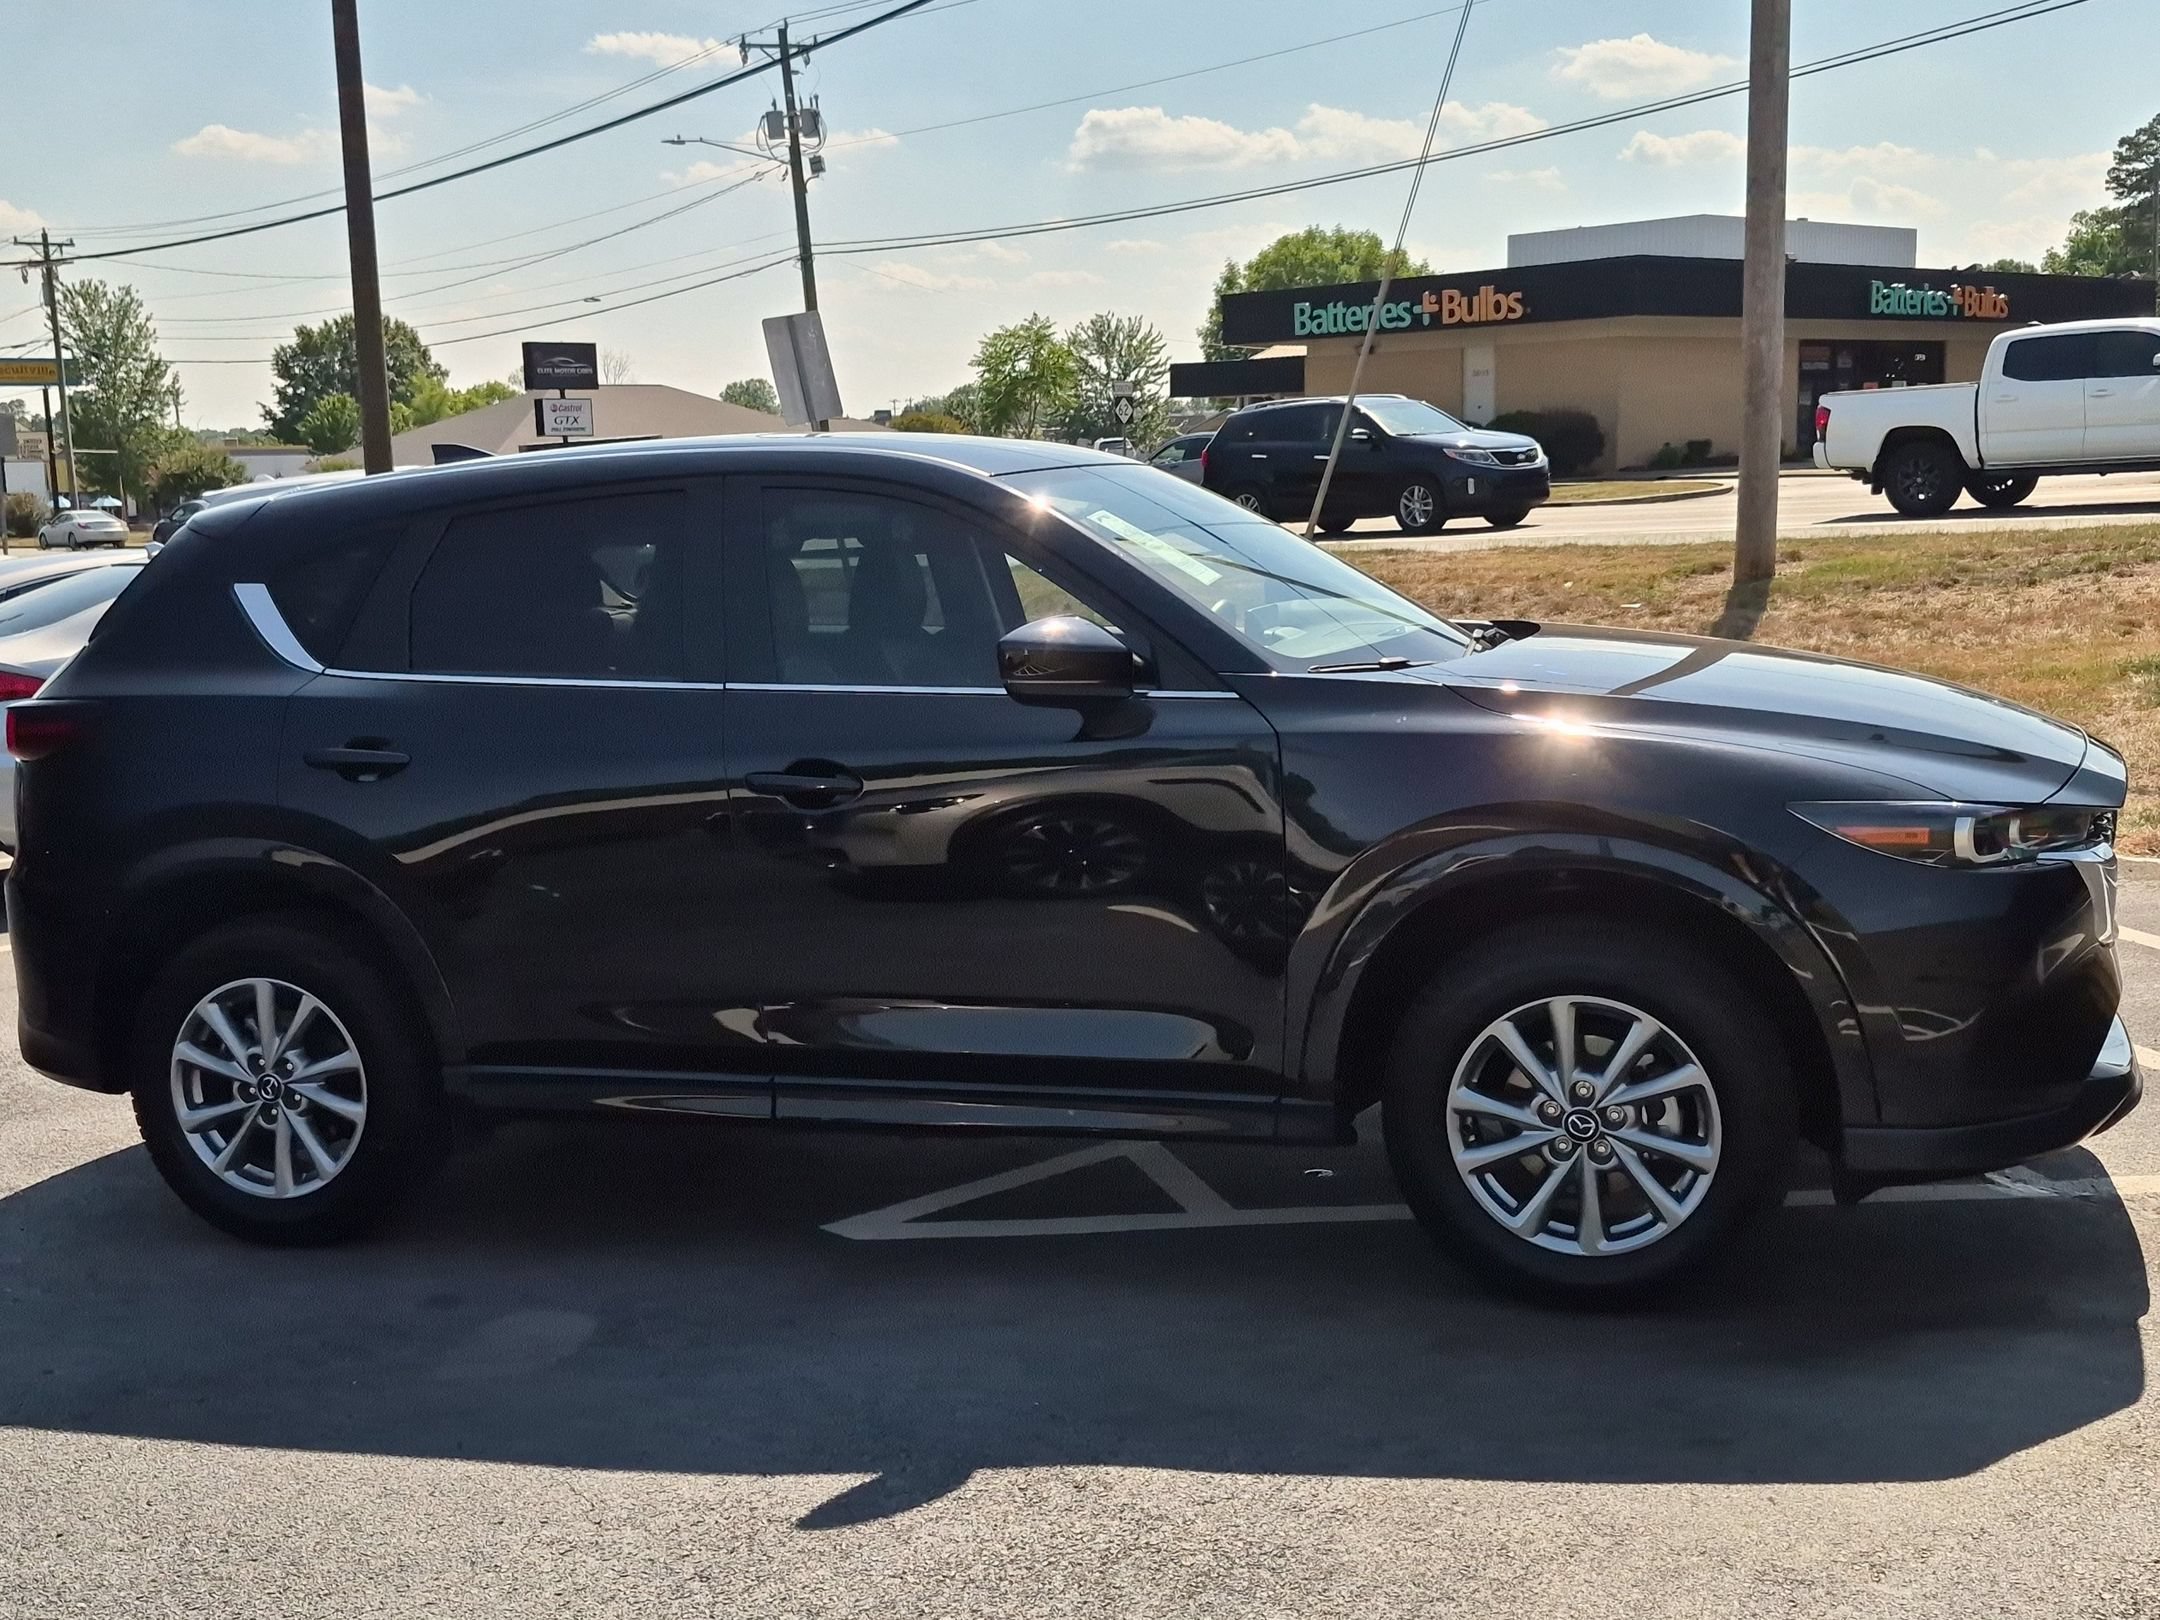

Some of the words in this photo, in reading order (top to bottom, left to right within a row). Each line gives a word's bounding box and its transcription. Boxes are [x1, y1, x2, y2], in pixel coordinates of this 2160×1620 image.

[1441, 285, 1524, 325] Bulbs
[1870, 280, 1948, 316] Batteries
[1964, 285, 2009, 318] Bulbs
[554, 415, 580, 425] GTX
